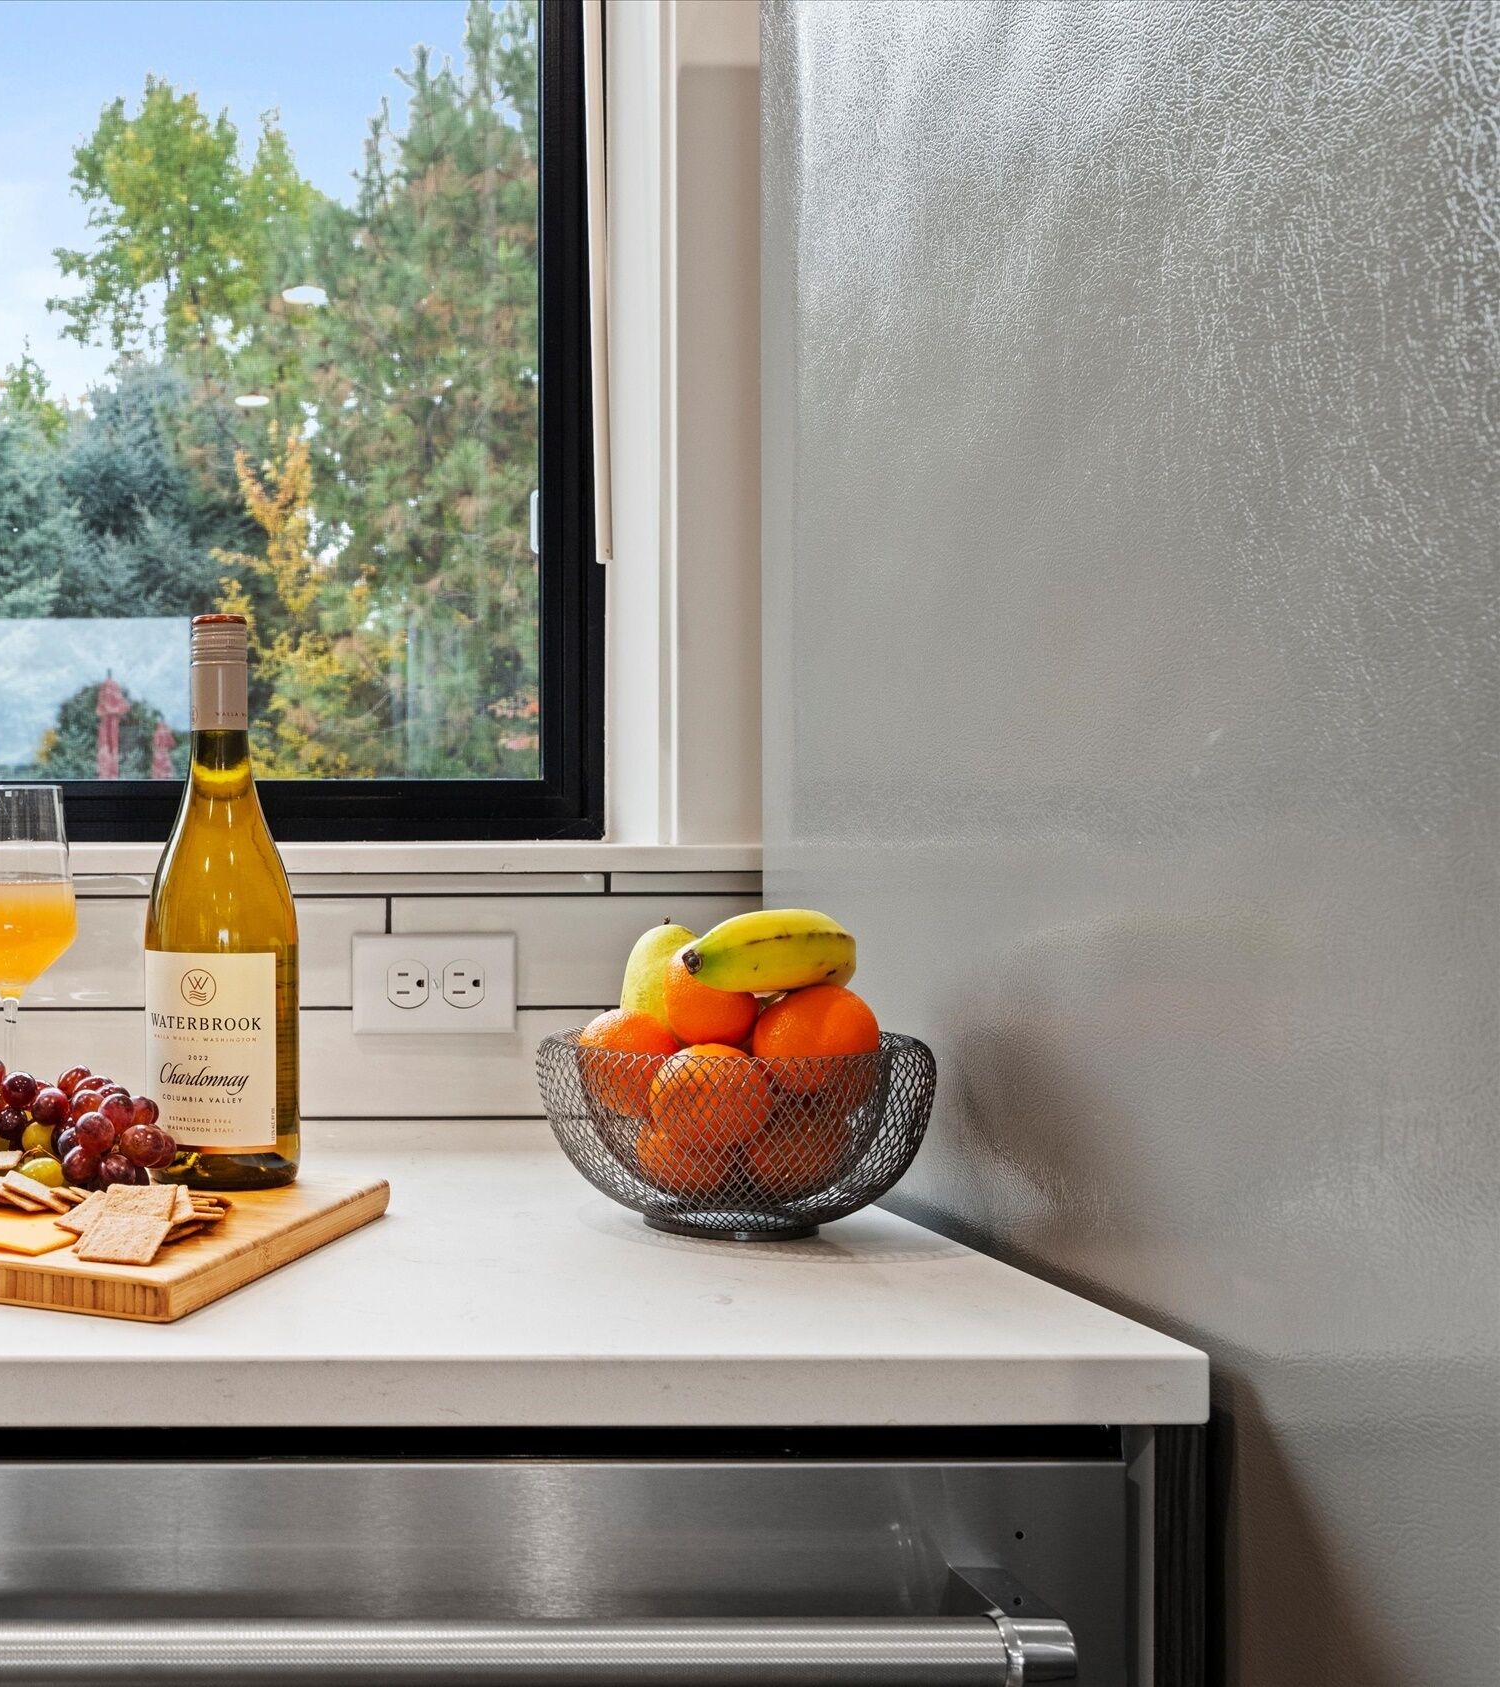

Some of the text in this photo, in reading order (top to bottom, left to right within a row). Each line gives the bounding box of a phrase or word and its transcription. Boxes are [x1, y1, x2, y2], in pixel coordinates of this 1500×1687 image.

[151, 1012, 261, 1031] WATERBROOK
[159, 1062, 249, 1096] Chardonnay
[162, 1093, 204, 1103] COLUMBIA
[169, 1115, 210, 1124] ESTABLISHED
[167, 1124, 211, 1133] WASHINGTON
